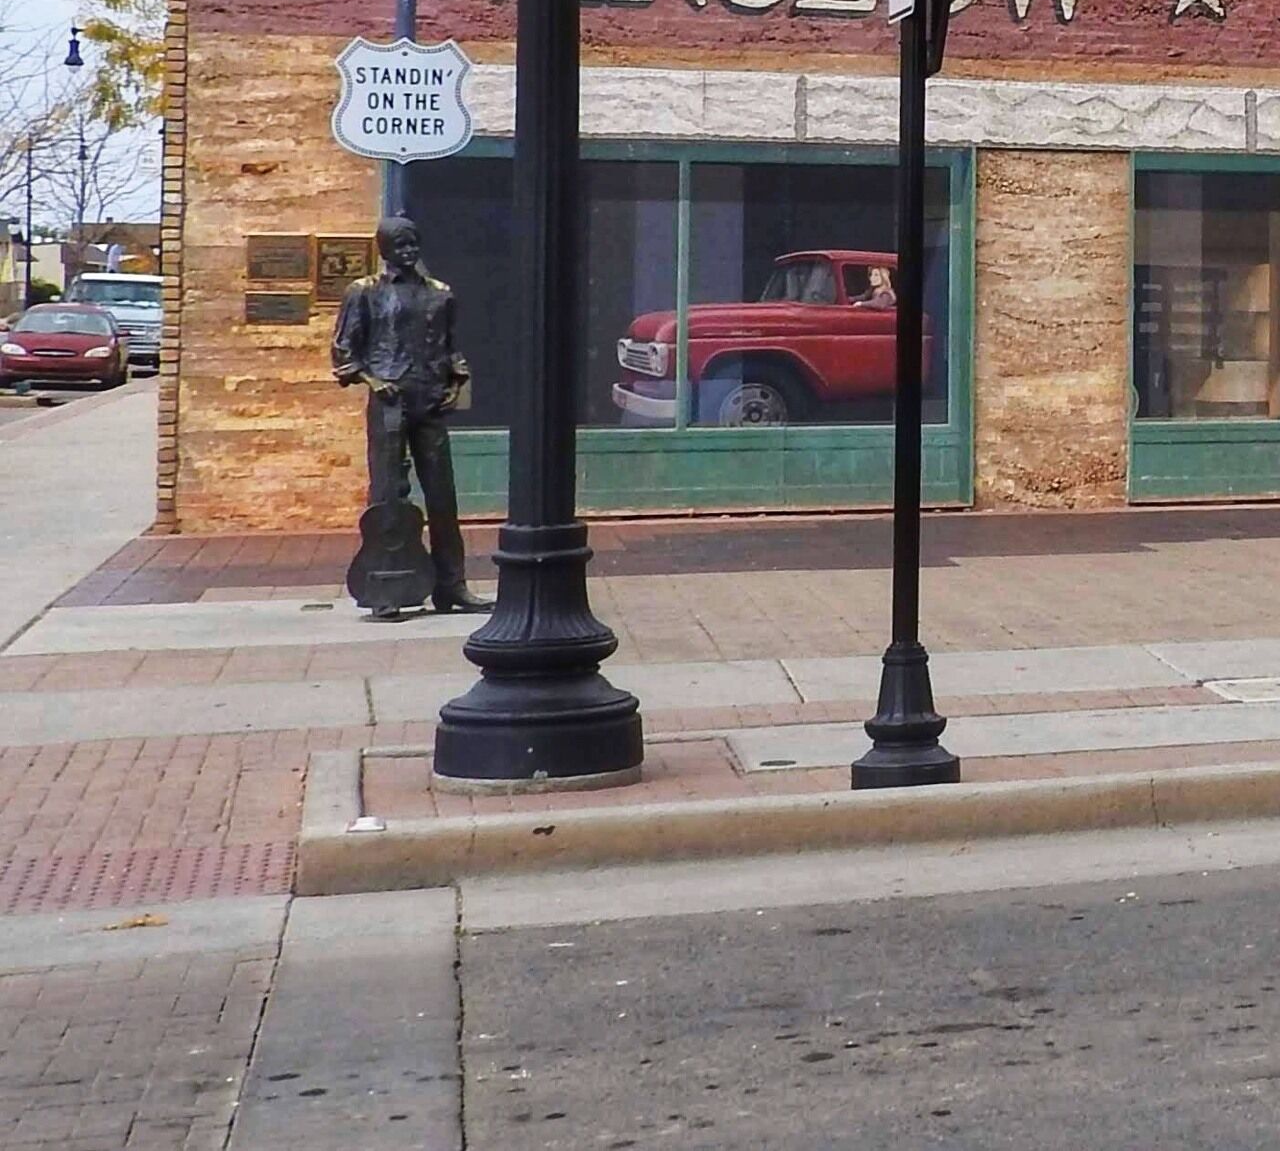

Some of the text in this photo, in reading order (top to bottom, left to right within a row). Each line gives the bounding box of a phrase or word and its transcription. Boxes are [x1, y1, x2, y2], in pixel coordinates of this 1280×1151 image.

[355, 67, 453, 86] STANDIN'
[367, 93, 440, 111] ON THE
[362, 116, 445, 136] CORNER
